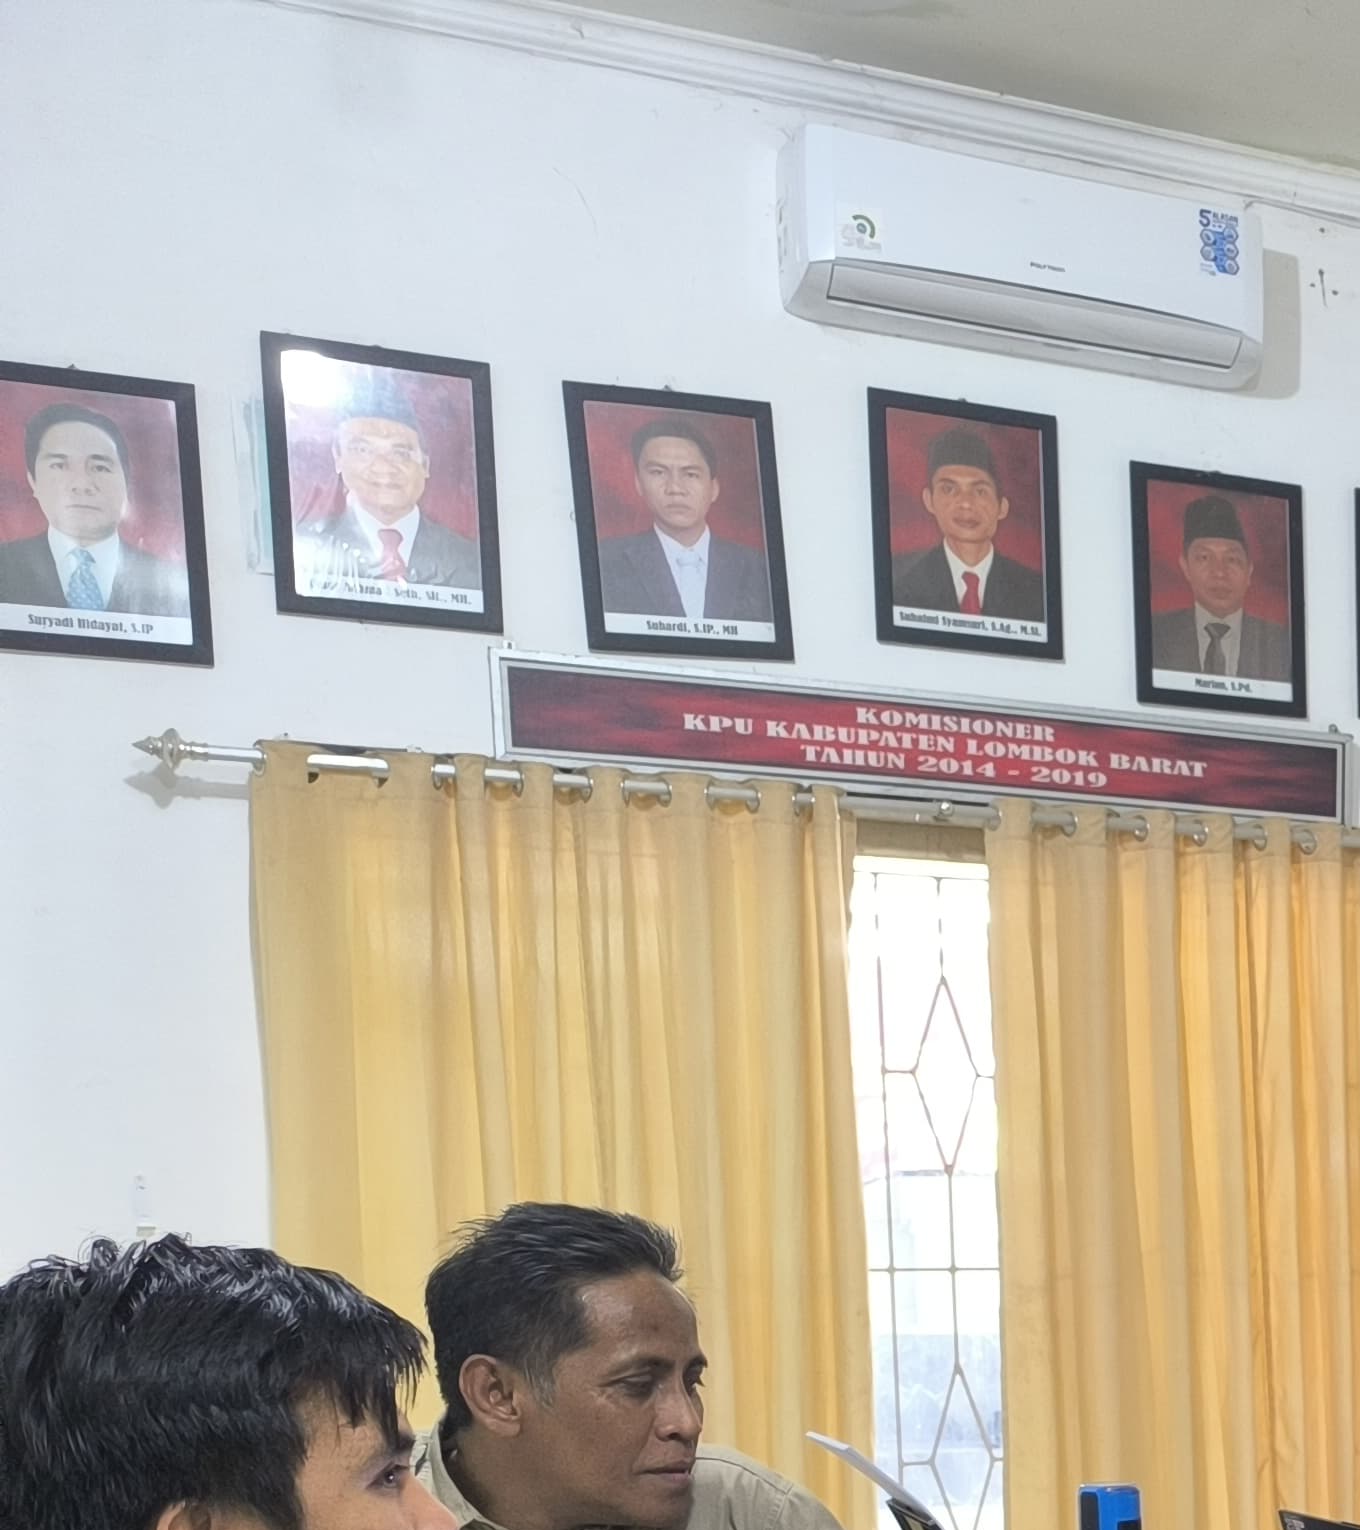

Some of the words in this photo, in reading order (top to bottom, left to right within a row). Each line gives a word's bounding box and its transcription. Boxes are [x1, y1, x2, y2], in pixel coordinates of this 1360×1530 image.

[682, 712, 753, 735] KPU
[766, 719, 955, 753] KABUPATEN
[966, 737, 1100, 768] LOMBOK
[1109, 752, 1208, 778] BARAT
[855, 706, 1055, 742] KOMISIONER
[800, 743, 905, 770] TAHUN
[916, 755, 997, 778] 2014
[1030, 766, 1108, 788] 2019
